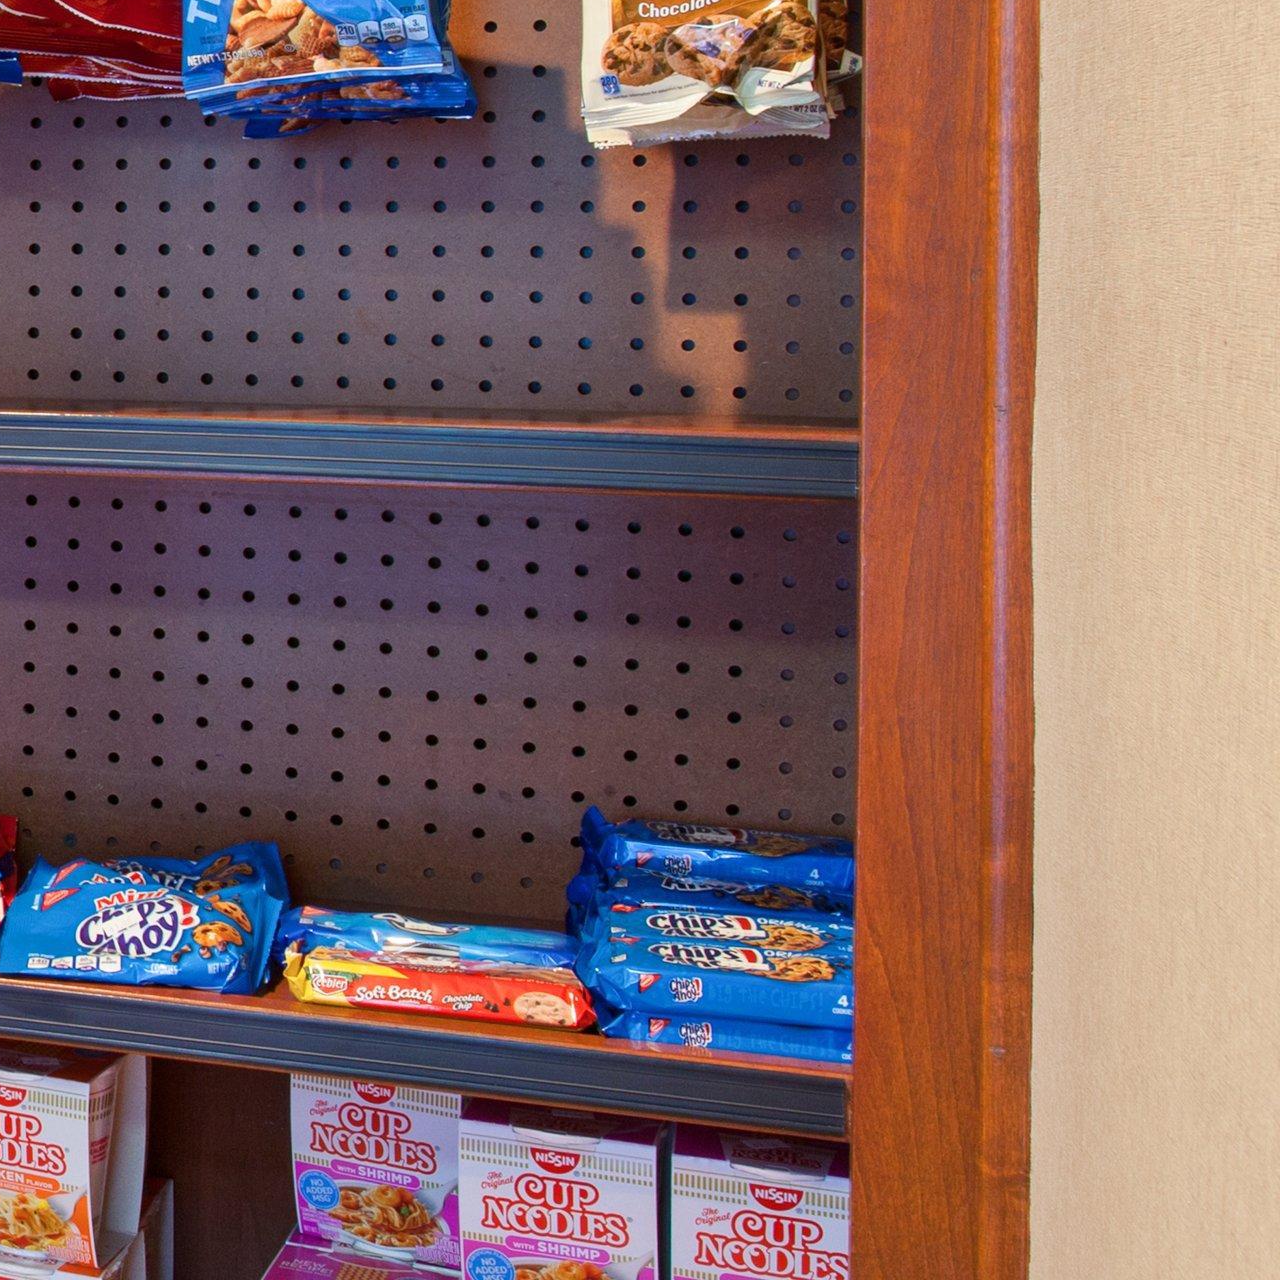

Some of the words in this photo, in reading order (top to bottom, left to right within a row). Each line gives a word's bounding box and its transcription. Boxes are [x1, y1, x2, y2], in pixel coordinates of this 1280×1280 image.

[355, 986, 385, 1002] Soft
[389, 986, 433, 1003] Batch
[670, 979, 695, 992] Chips
[442, 994, 484, 1003] Chocolate
[452, 1001, 473, 1011] Chip
[356, 1083, 391, 1098] NISSIN
[338, 1102, 411, 1138] CUP
[310, 1122, 437, 1175] NOODLES
[534, 1151, 575, 1167] NISSIN
[358, 1167, 412, 1186] SHRIMP
[514, 1172, 599, 1212] CUP
[754, 1187, 798, 1204] NISSIN
[482, 1195, 629, 1248] NOODLES
[731, 1210, 823, 1250] CUP
[537, 1241, 600, 1261] SHRIMP
[696, 1232, 848, 1280] NOODLES
